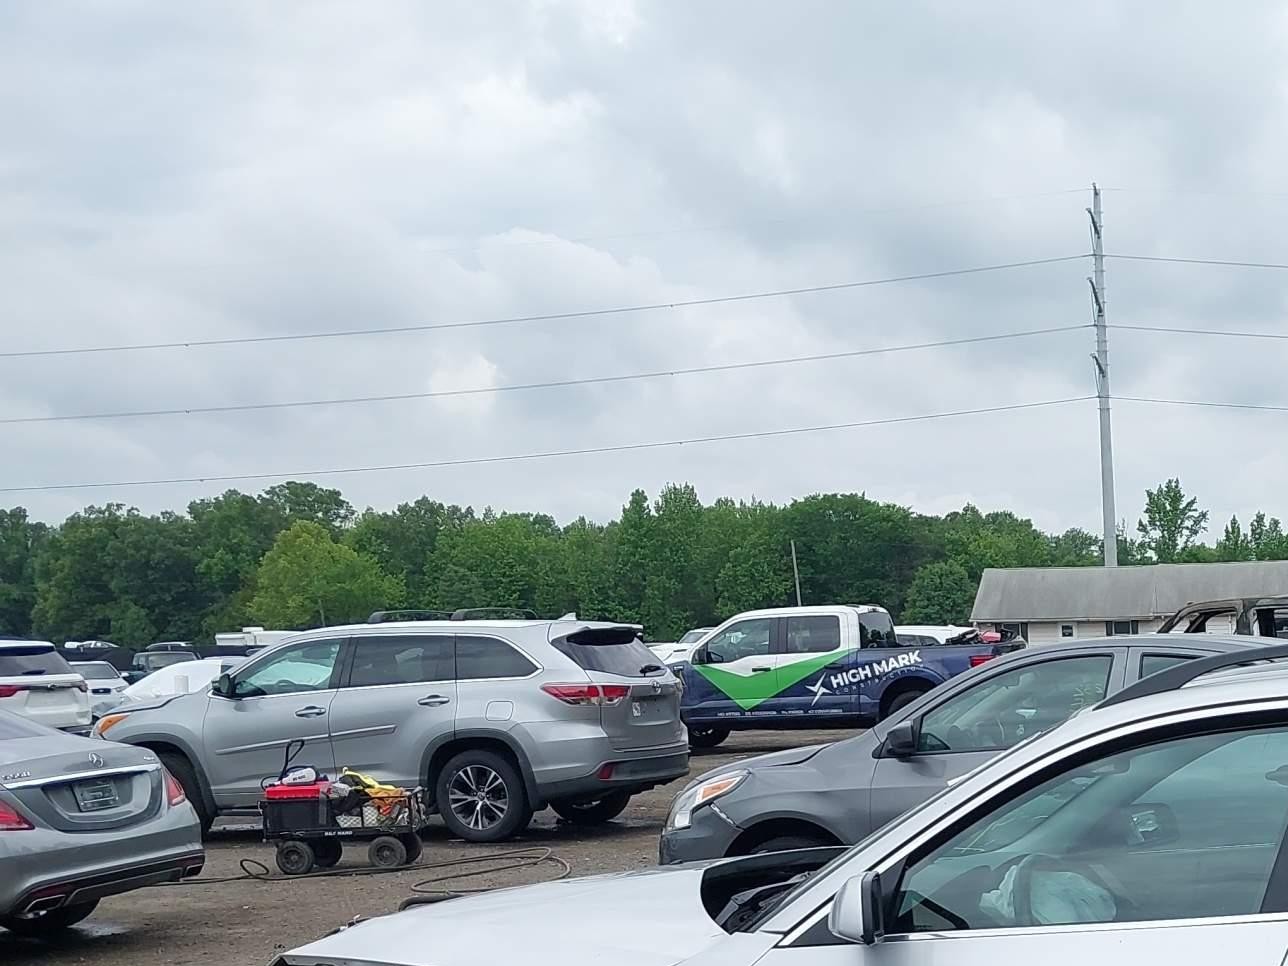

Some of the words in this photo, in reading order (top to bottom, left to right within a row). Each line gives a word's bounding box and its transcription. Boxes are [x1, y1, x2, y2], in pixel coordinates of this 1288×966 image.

[830, 664, 872, 688] HIGH
[873, 650, 922, 675] MARK
[835, 663, 924, 695] CONSTRUCTION
